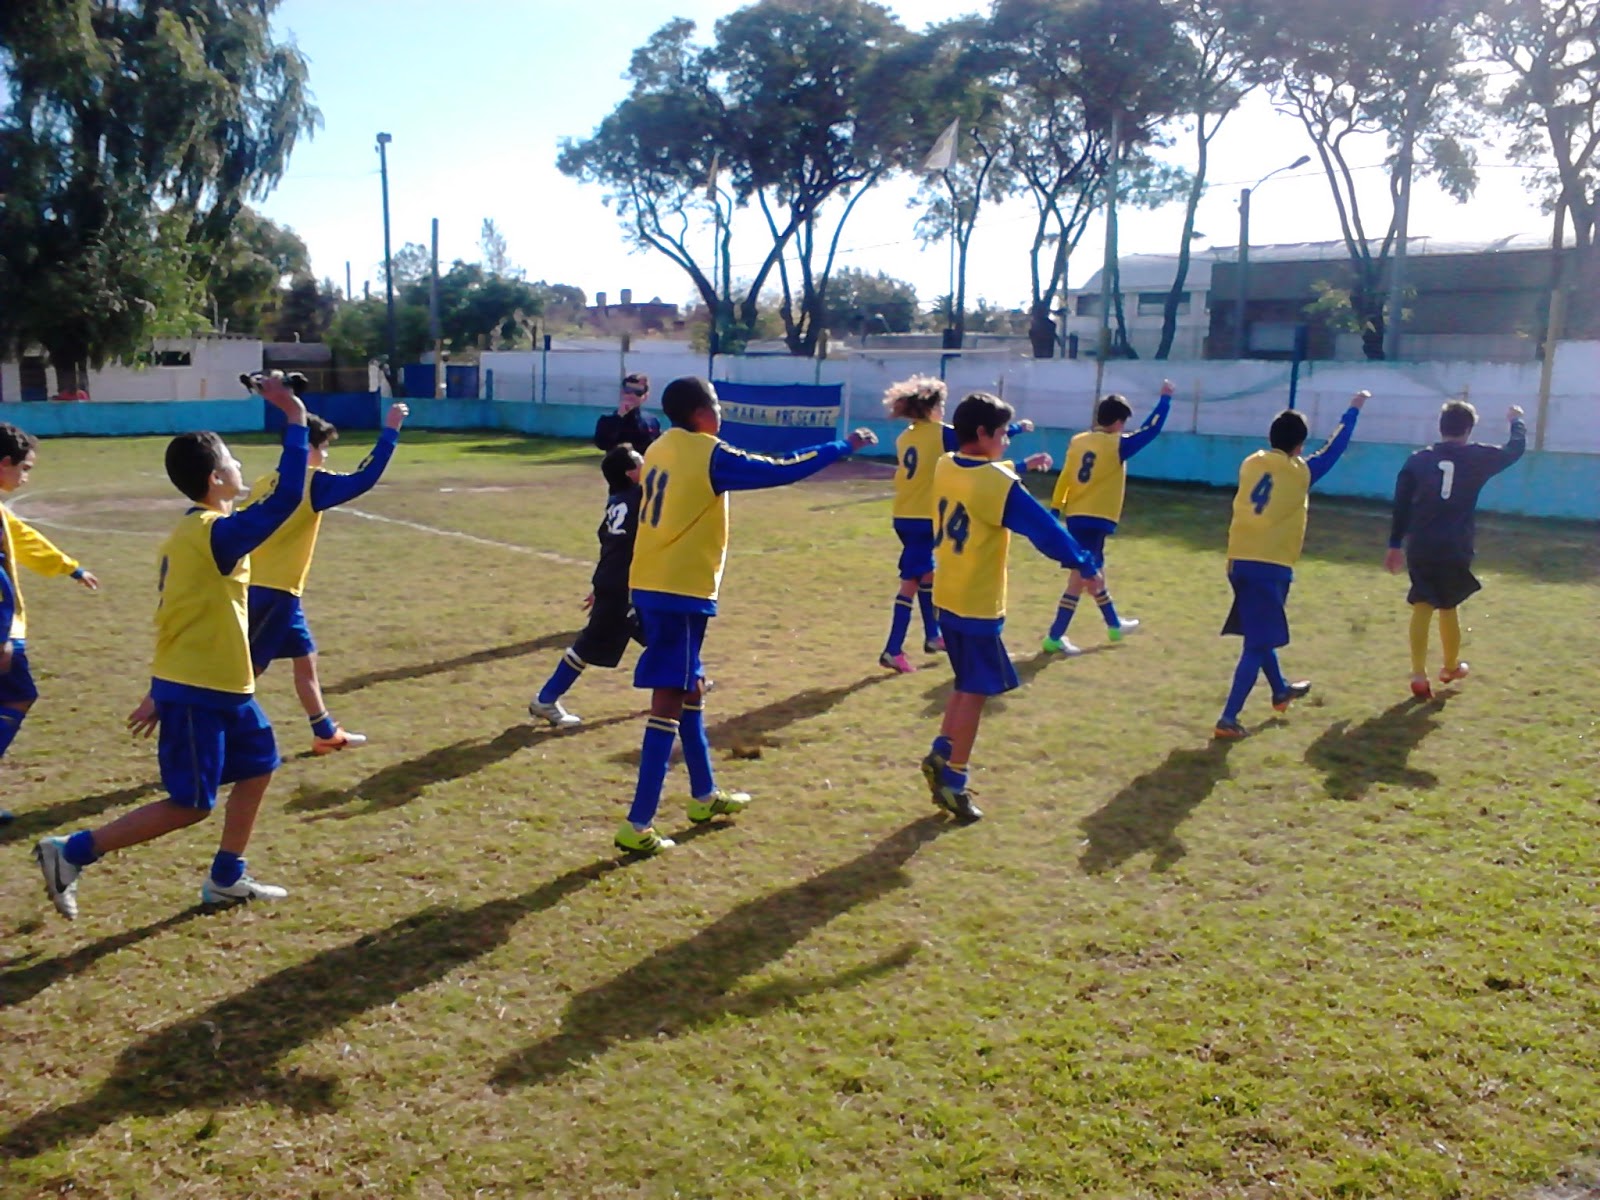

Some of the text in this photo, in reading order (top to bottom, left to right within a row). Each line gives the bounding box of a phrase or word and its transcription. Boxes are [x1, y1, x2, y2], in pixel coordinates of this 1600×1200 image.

[904, 446, 918, 480] 9
[1078, 450, 1096, 484] 8
[1438, 460, 1454, 499] 1
[641, 466, 669, 528] 11
[1250, 472, 1273, 515] 4
[935, 497, 970, 554] 14
